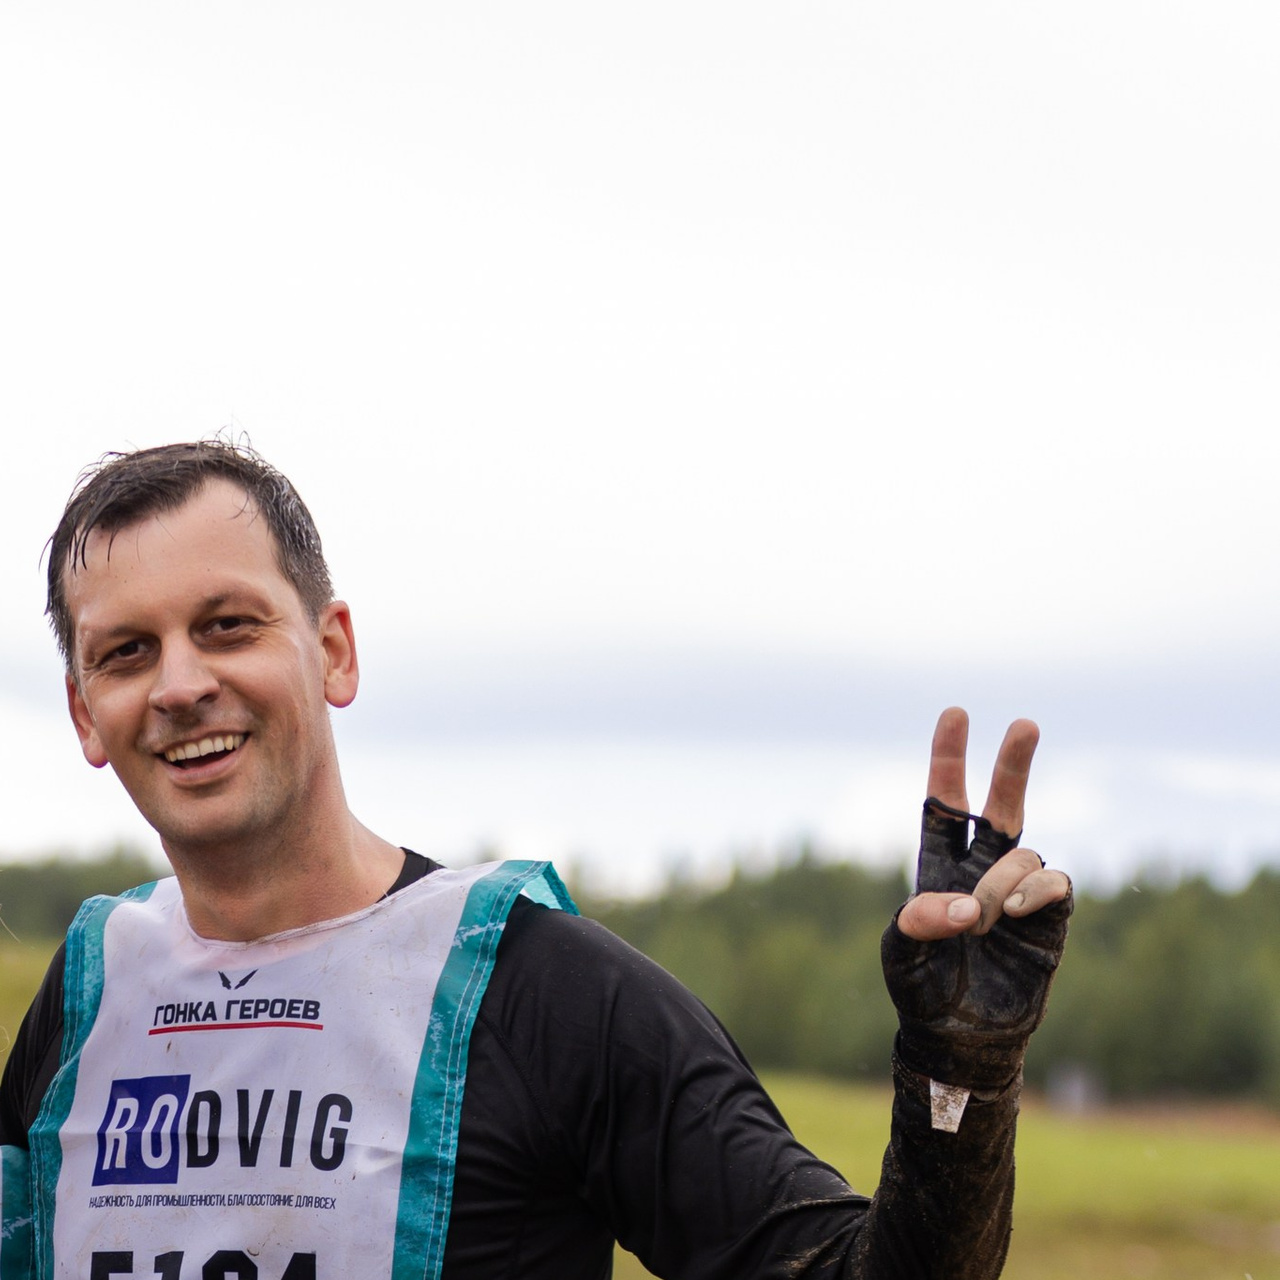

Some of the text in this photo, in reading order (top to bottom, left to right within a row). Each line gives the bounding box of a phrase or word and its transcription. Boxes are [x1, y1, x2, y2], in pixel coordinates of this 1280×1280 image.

[153, 998, 321, 1026] ГОНКА ГЕРОЕВ
[101, 1088, 354, 1173] RODVIG
[88, 1195, 134, 1208] НАДЕЖНОСТЬ
[135, 1194, 152, 1208] ДЛЯ
[227, 1193, 294, 1208] БЛАГОСОСТОЯНИЕ
[295, 1194, 313, 1209] ДЛЯ
[314, 1196, 337, 1210] ВСЕХ
